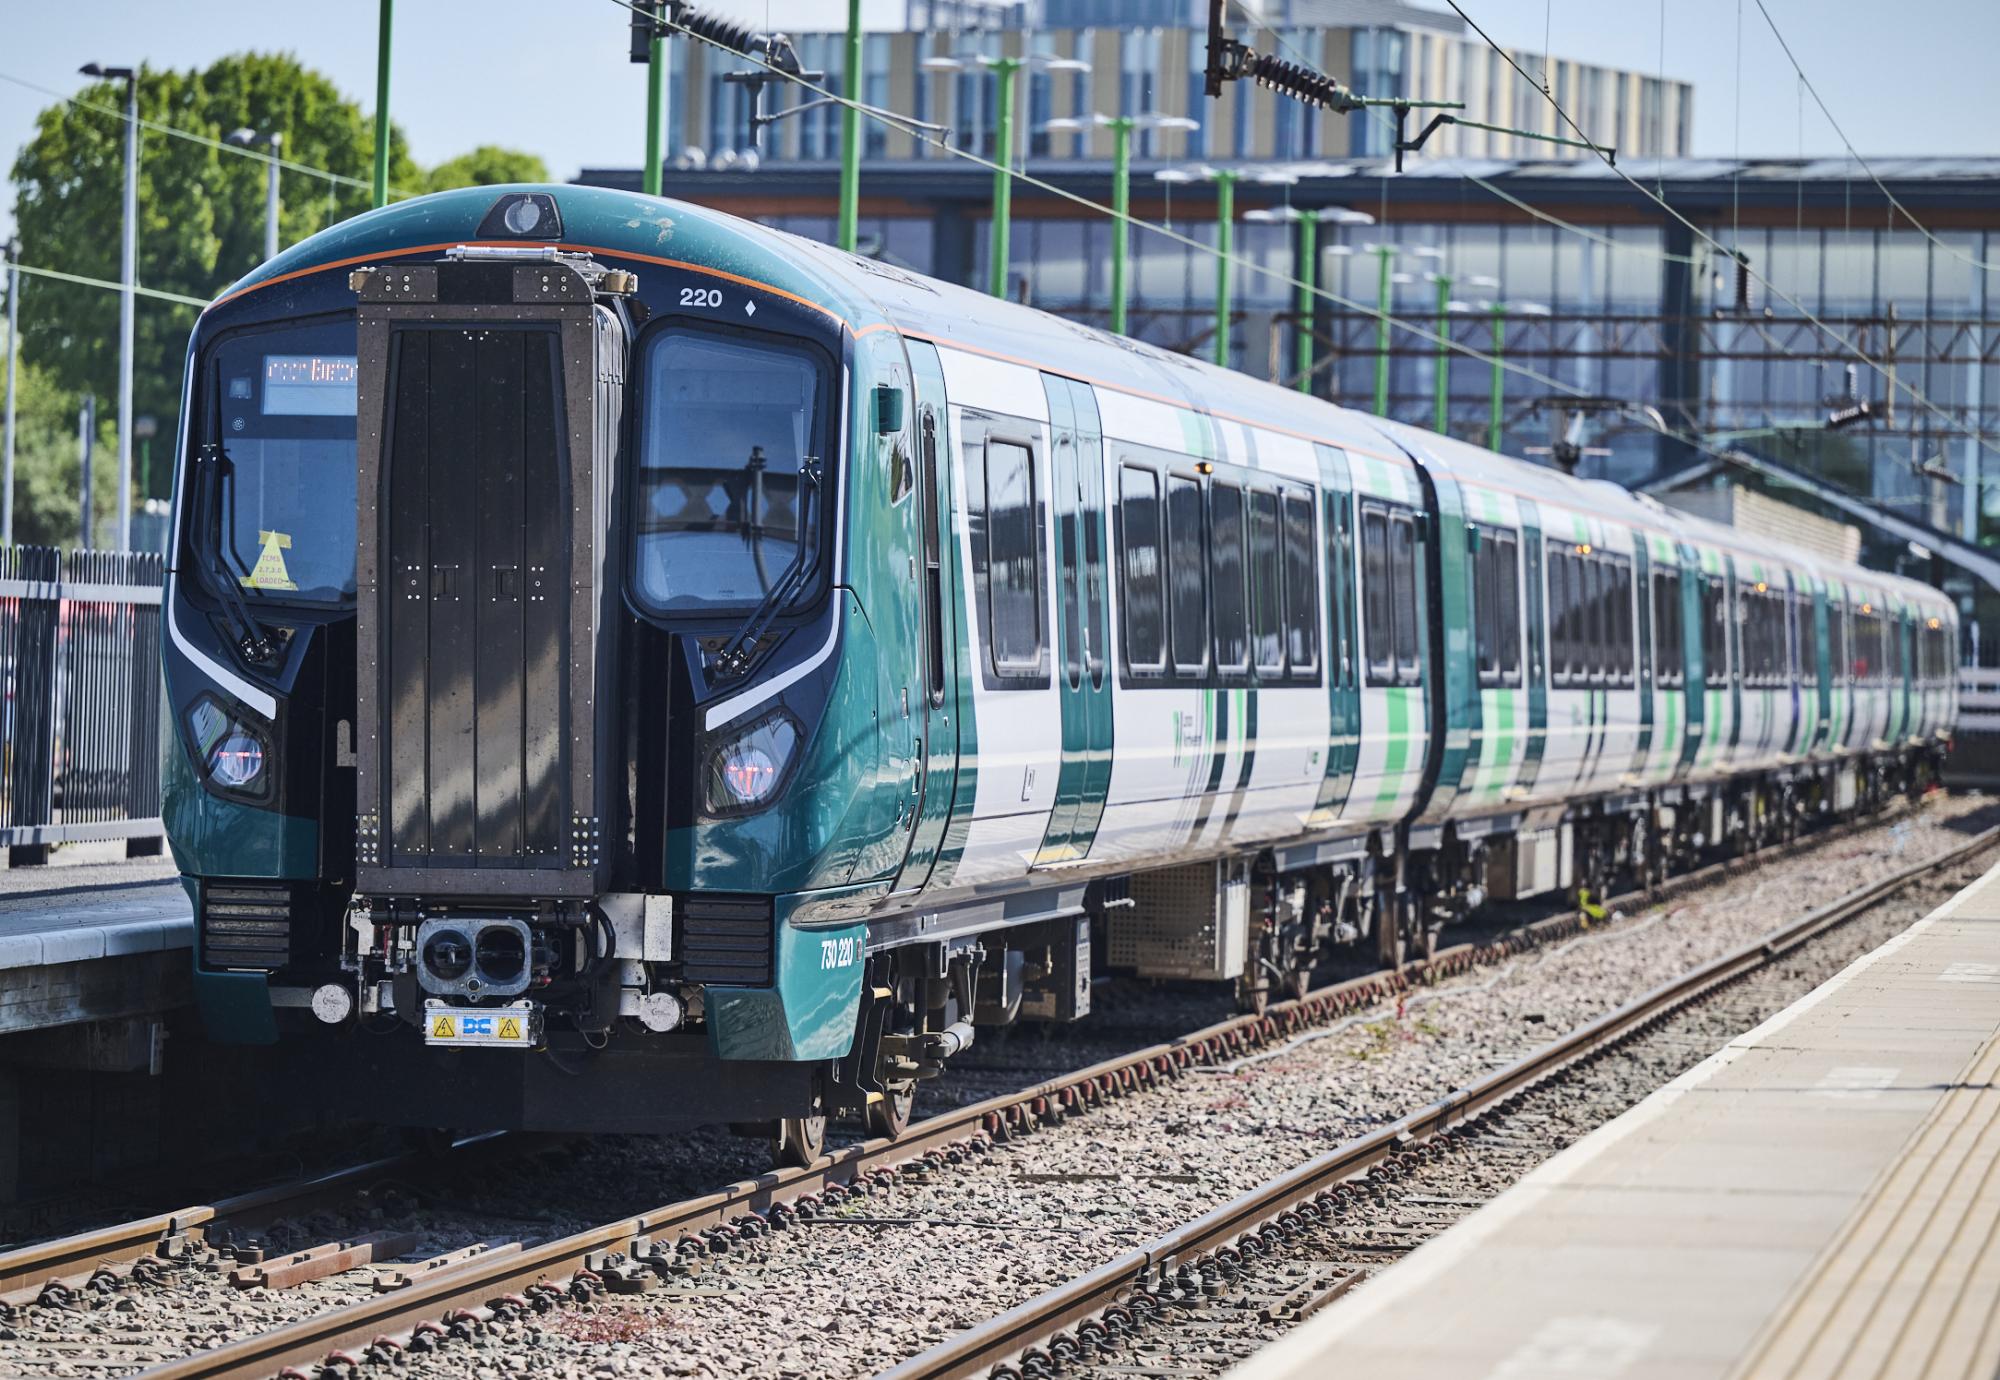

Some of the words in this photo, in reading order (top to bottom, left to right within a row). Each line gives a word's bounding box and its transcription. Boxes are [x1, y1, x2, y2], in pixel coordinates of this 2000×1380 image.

[680, 288, 723, 308] 220
[256, 576, 283, 584] LOADED
[821, 939, 838, 970] 730
[838, 936, 854, 967] 220
